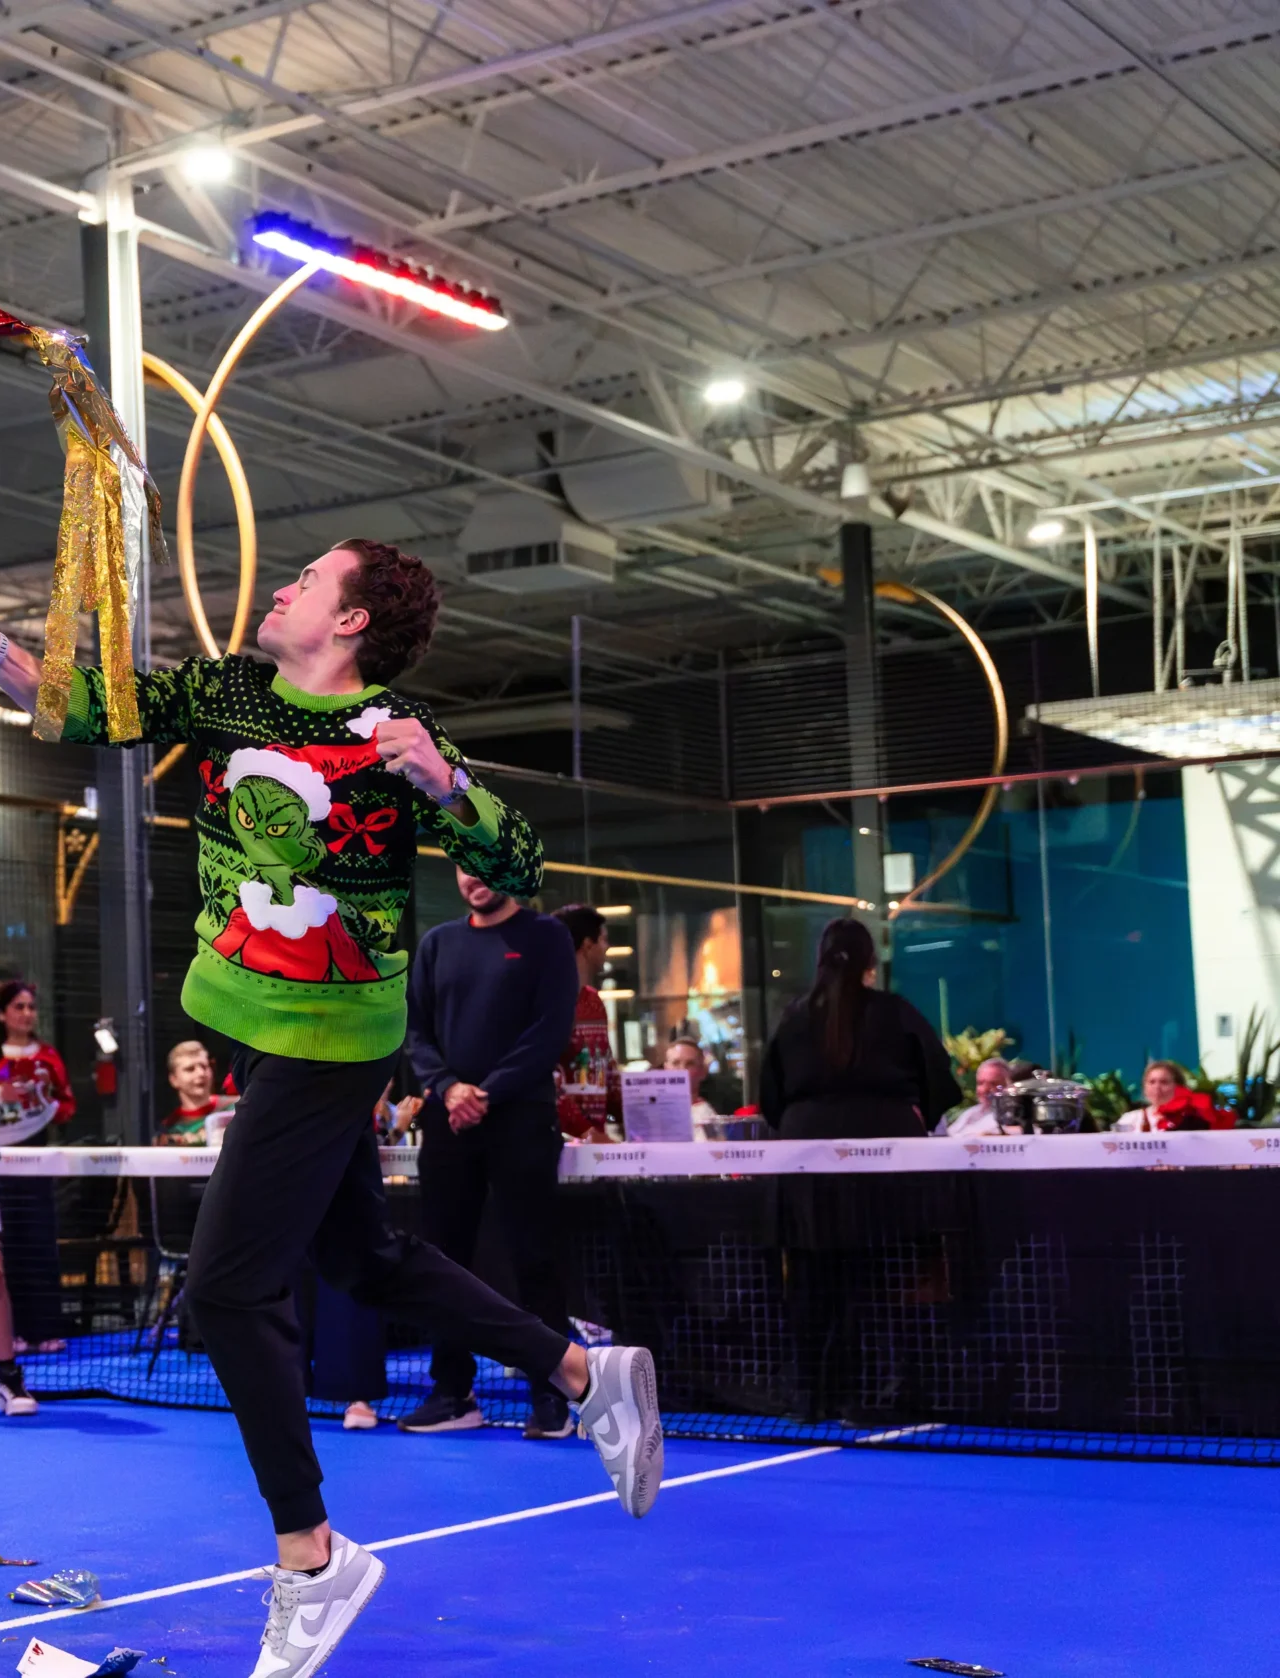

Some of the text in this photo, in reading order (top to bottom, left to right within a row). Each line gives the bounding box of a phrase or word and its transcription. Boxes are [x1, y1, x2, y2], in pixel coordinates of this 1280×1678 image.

[979, 1144, 1025, 1154] CONQUER
[1119, 1140, 1168, 1151] CONQUER
[848, 1147, 892, 1157] CONQUER
